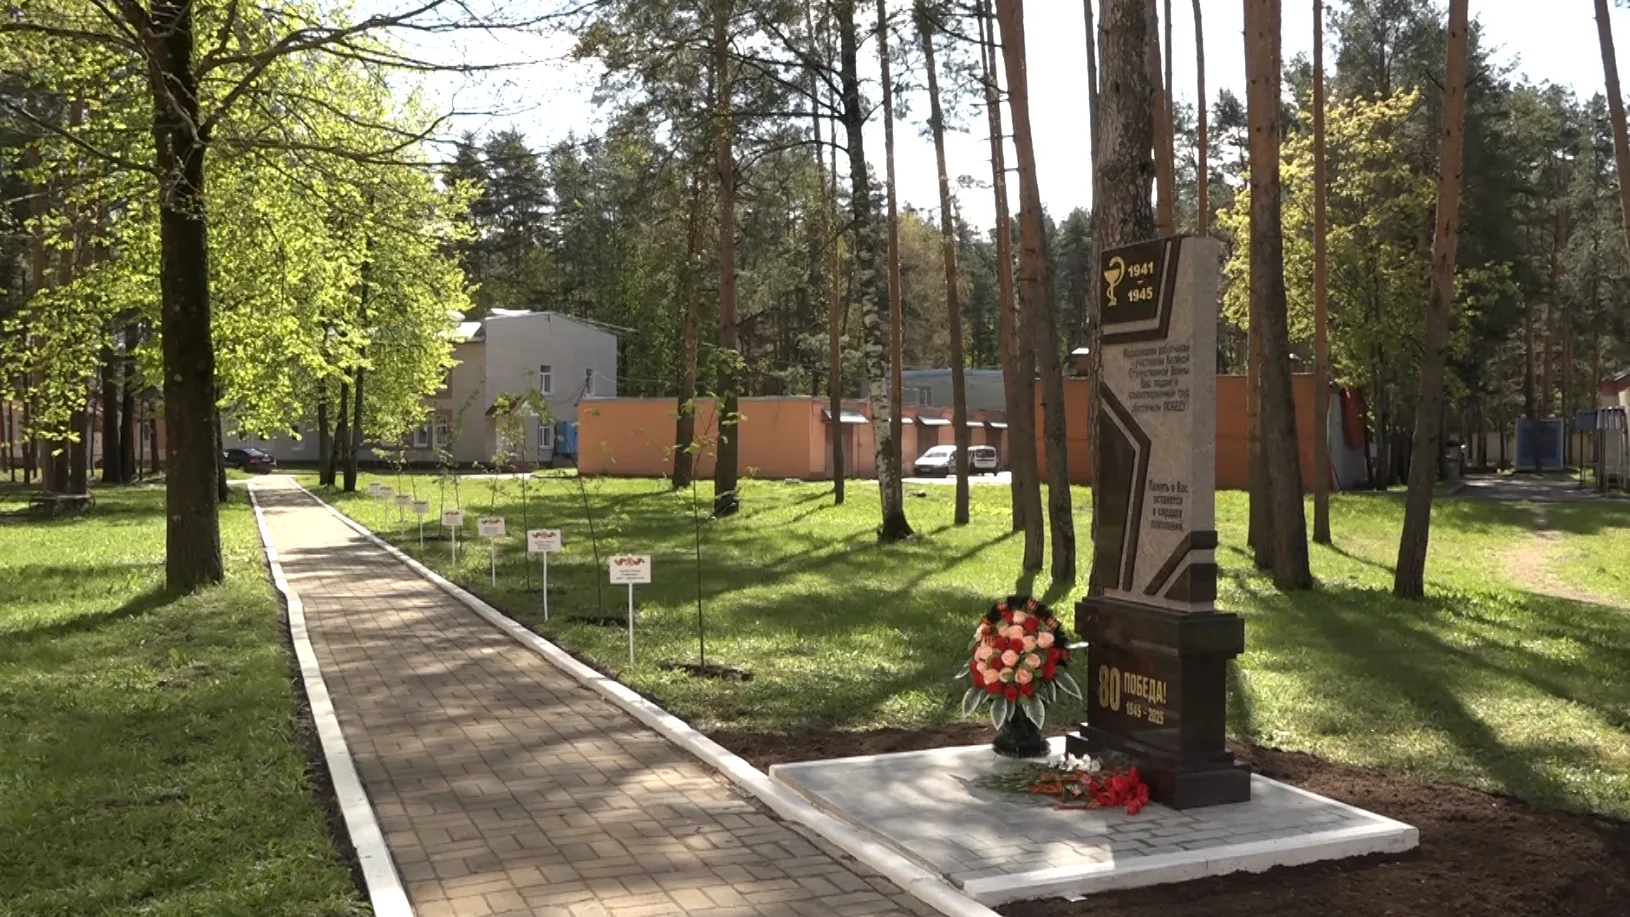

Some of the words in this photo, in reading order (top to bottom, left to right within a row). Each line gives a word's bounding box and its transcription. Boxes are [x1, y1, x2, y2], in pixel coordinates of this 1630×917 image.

[1127, 261, 1154, 278] 1941
[1127, 286, 1153, 302] 1945
[1149, 480, 1169, 492] Память
[1177, 481, 1188, 493] Вас
[1099, 664, 1120, 711] 80
[1124, 672, 1167, 704] ПОБЕДА!
[1126, 701, 1142, 718] 1945
[1148, 707, 1164, 725] 2025
